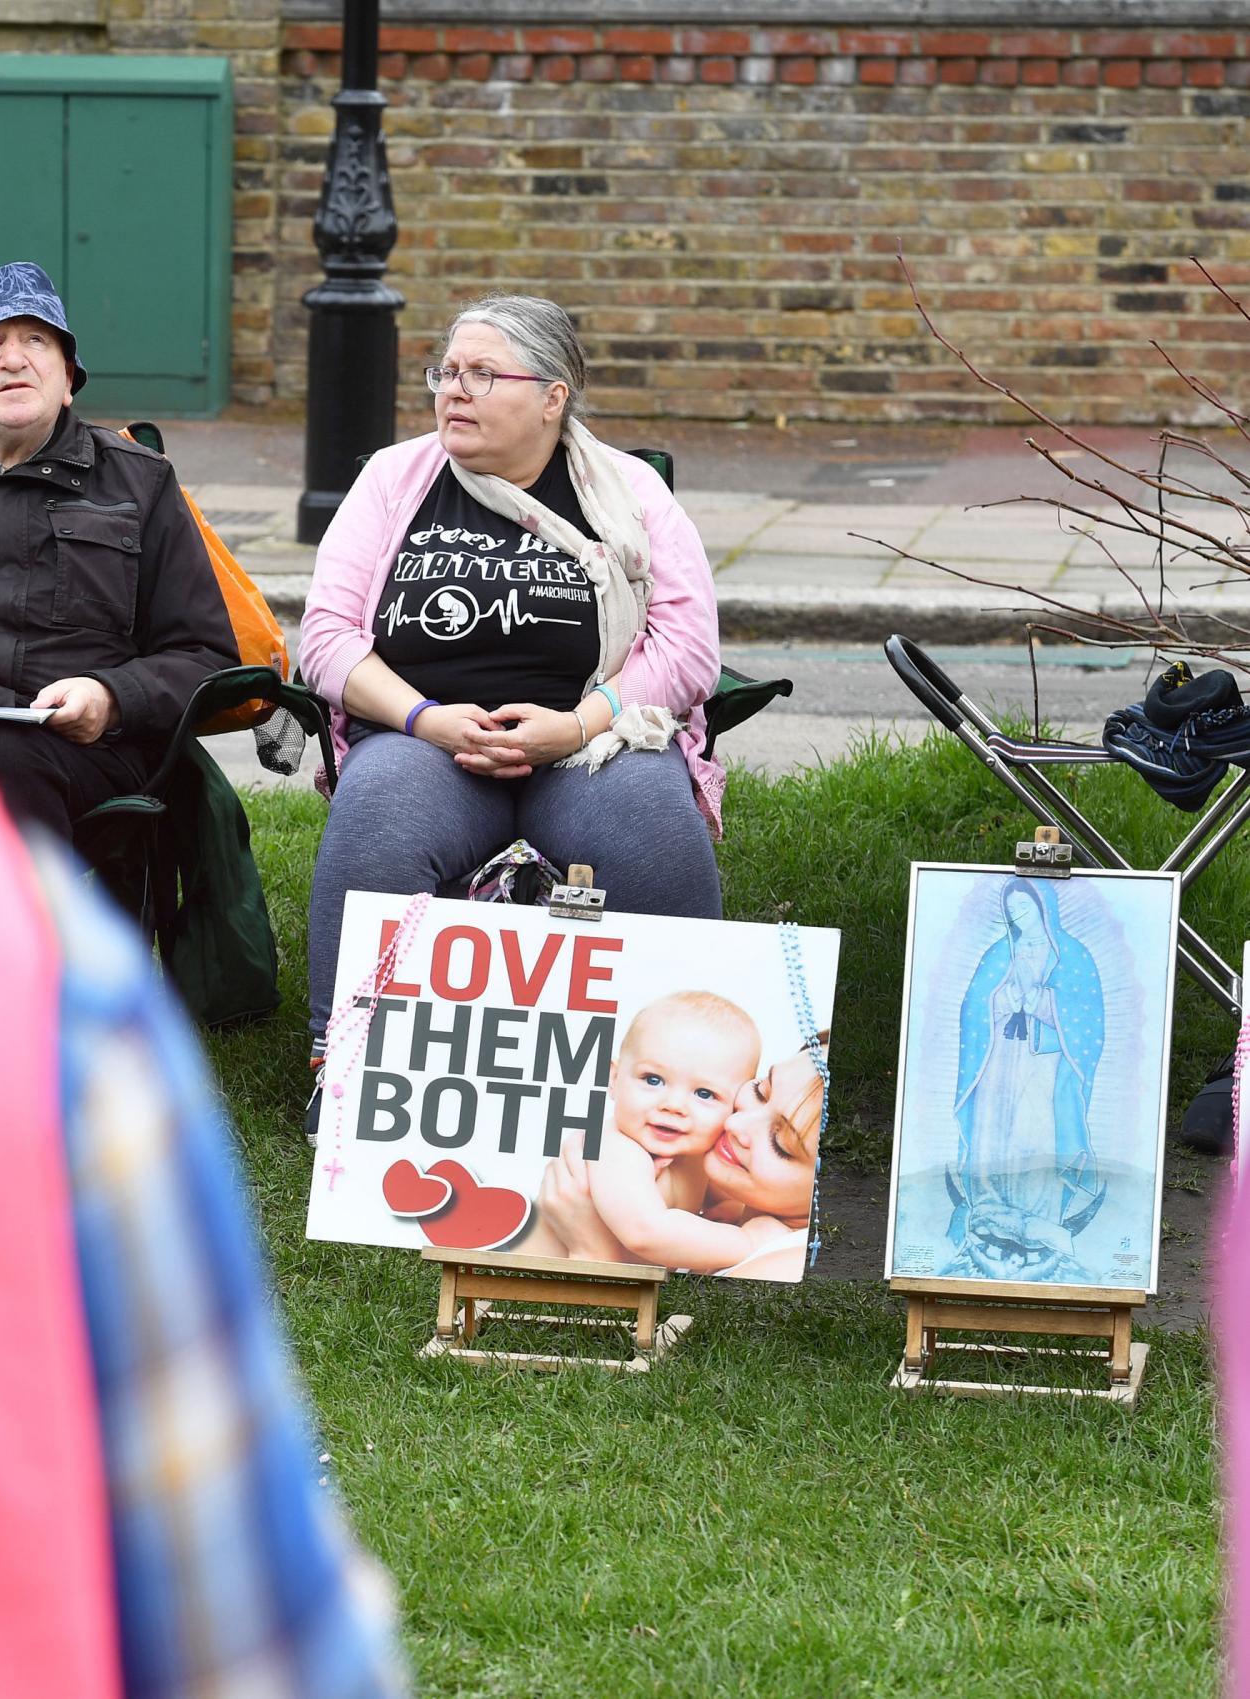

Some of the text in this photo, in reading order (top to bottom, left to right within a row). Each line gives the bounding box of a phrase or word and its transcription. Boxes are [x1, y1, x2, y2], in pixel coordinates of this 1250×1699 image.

[394, 551, 588, 586] MATTERS
[514, 532, 566, 554] Li
[374, 919, 623, 1014] LOVE
[354, 997, 616, 1088] THEM
[356, 1070, 607, 1161] BOTH
